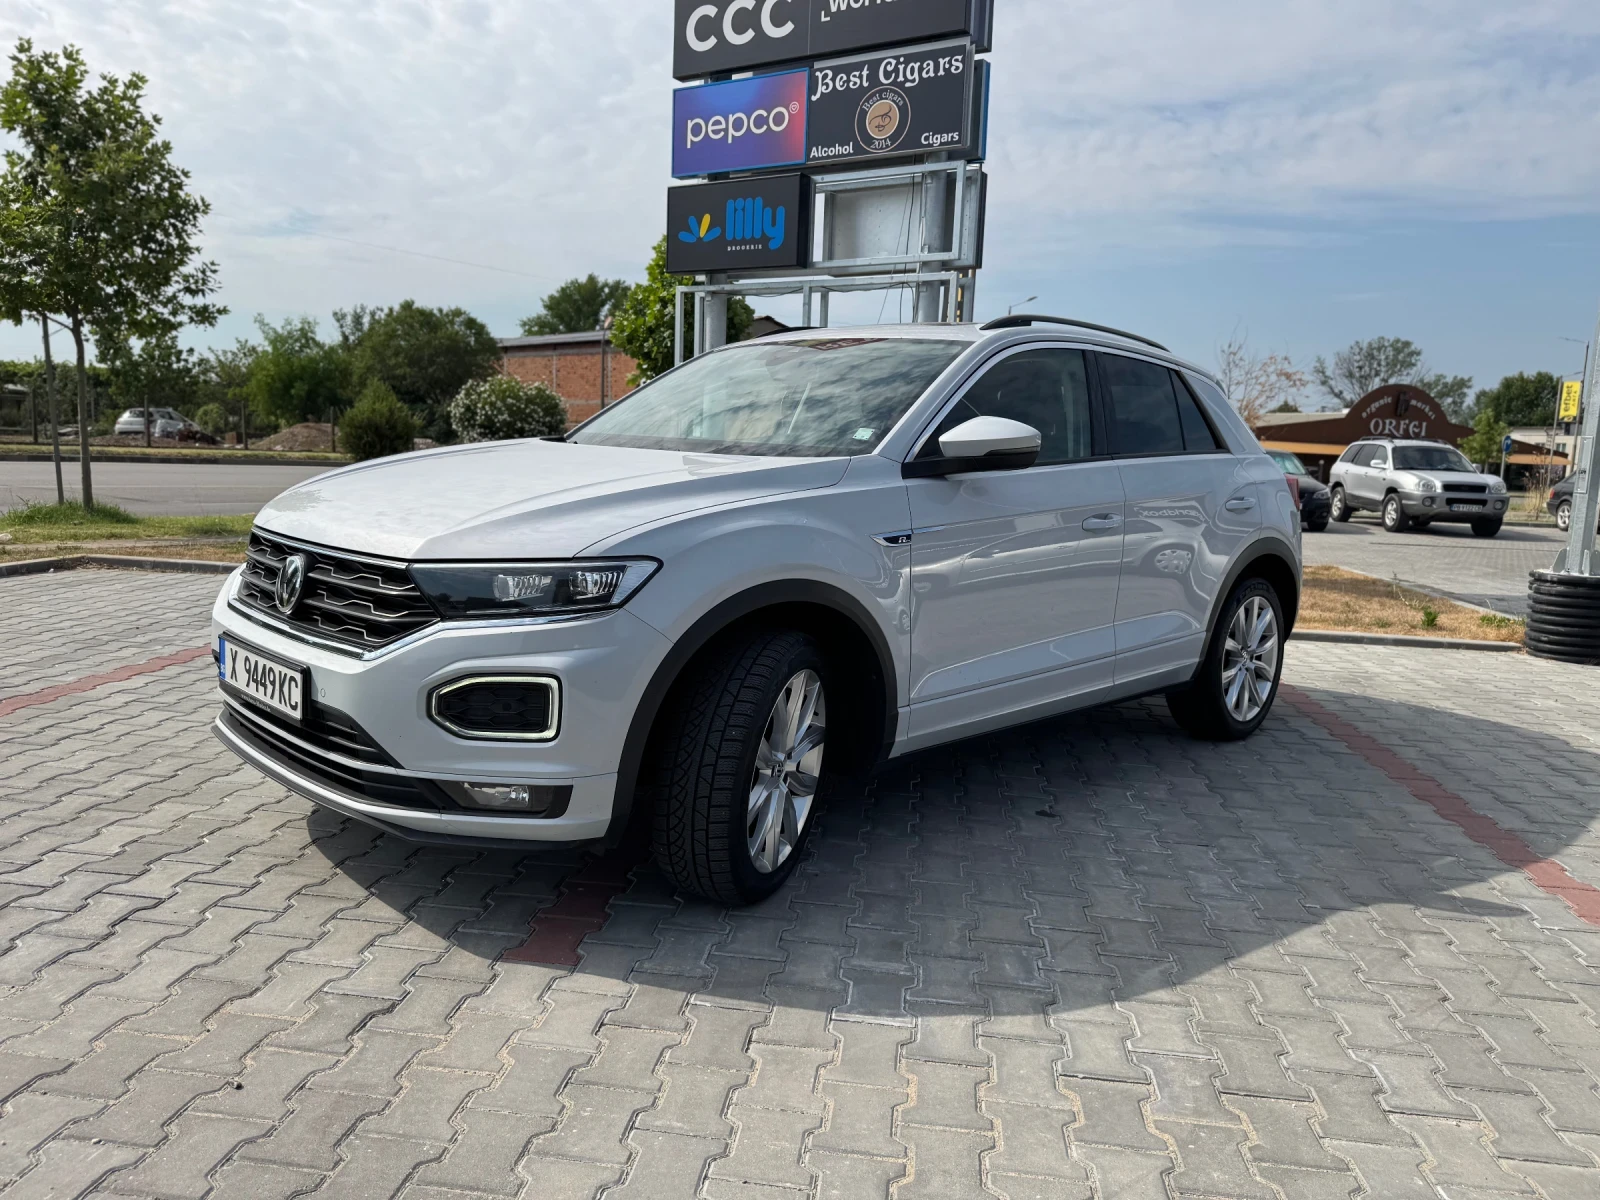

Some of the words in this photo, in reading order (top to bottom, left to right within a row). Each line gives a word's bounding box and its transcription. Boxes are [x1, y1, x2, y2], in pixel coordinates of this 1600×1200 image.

[686, 0, 795, 52] CCC
[811, 64, 870, 102] Best
[878, 54, 964, 88] Cigars
[862, 93, 881, 112] Best
[881, 89, 905, 107] cigars
[686, 106, 789, 149] pepco
[870, 138, 892, 149] 2014
[920, 131, 960, 147] Cigars
[809, 142, 854, 159] Alcohol
[725, 196, 786, 250] lilly
[1563, 384, 1573, 412] efbet
[230, 647, 238, 683] X
